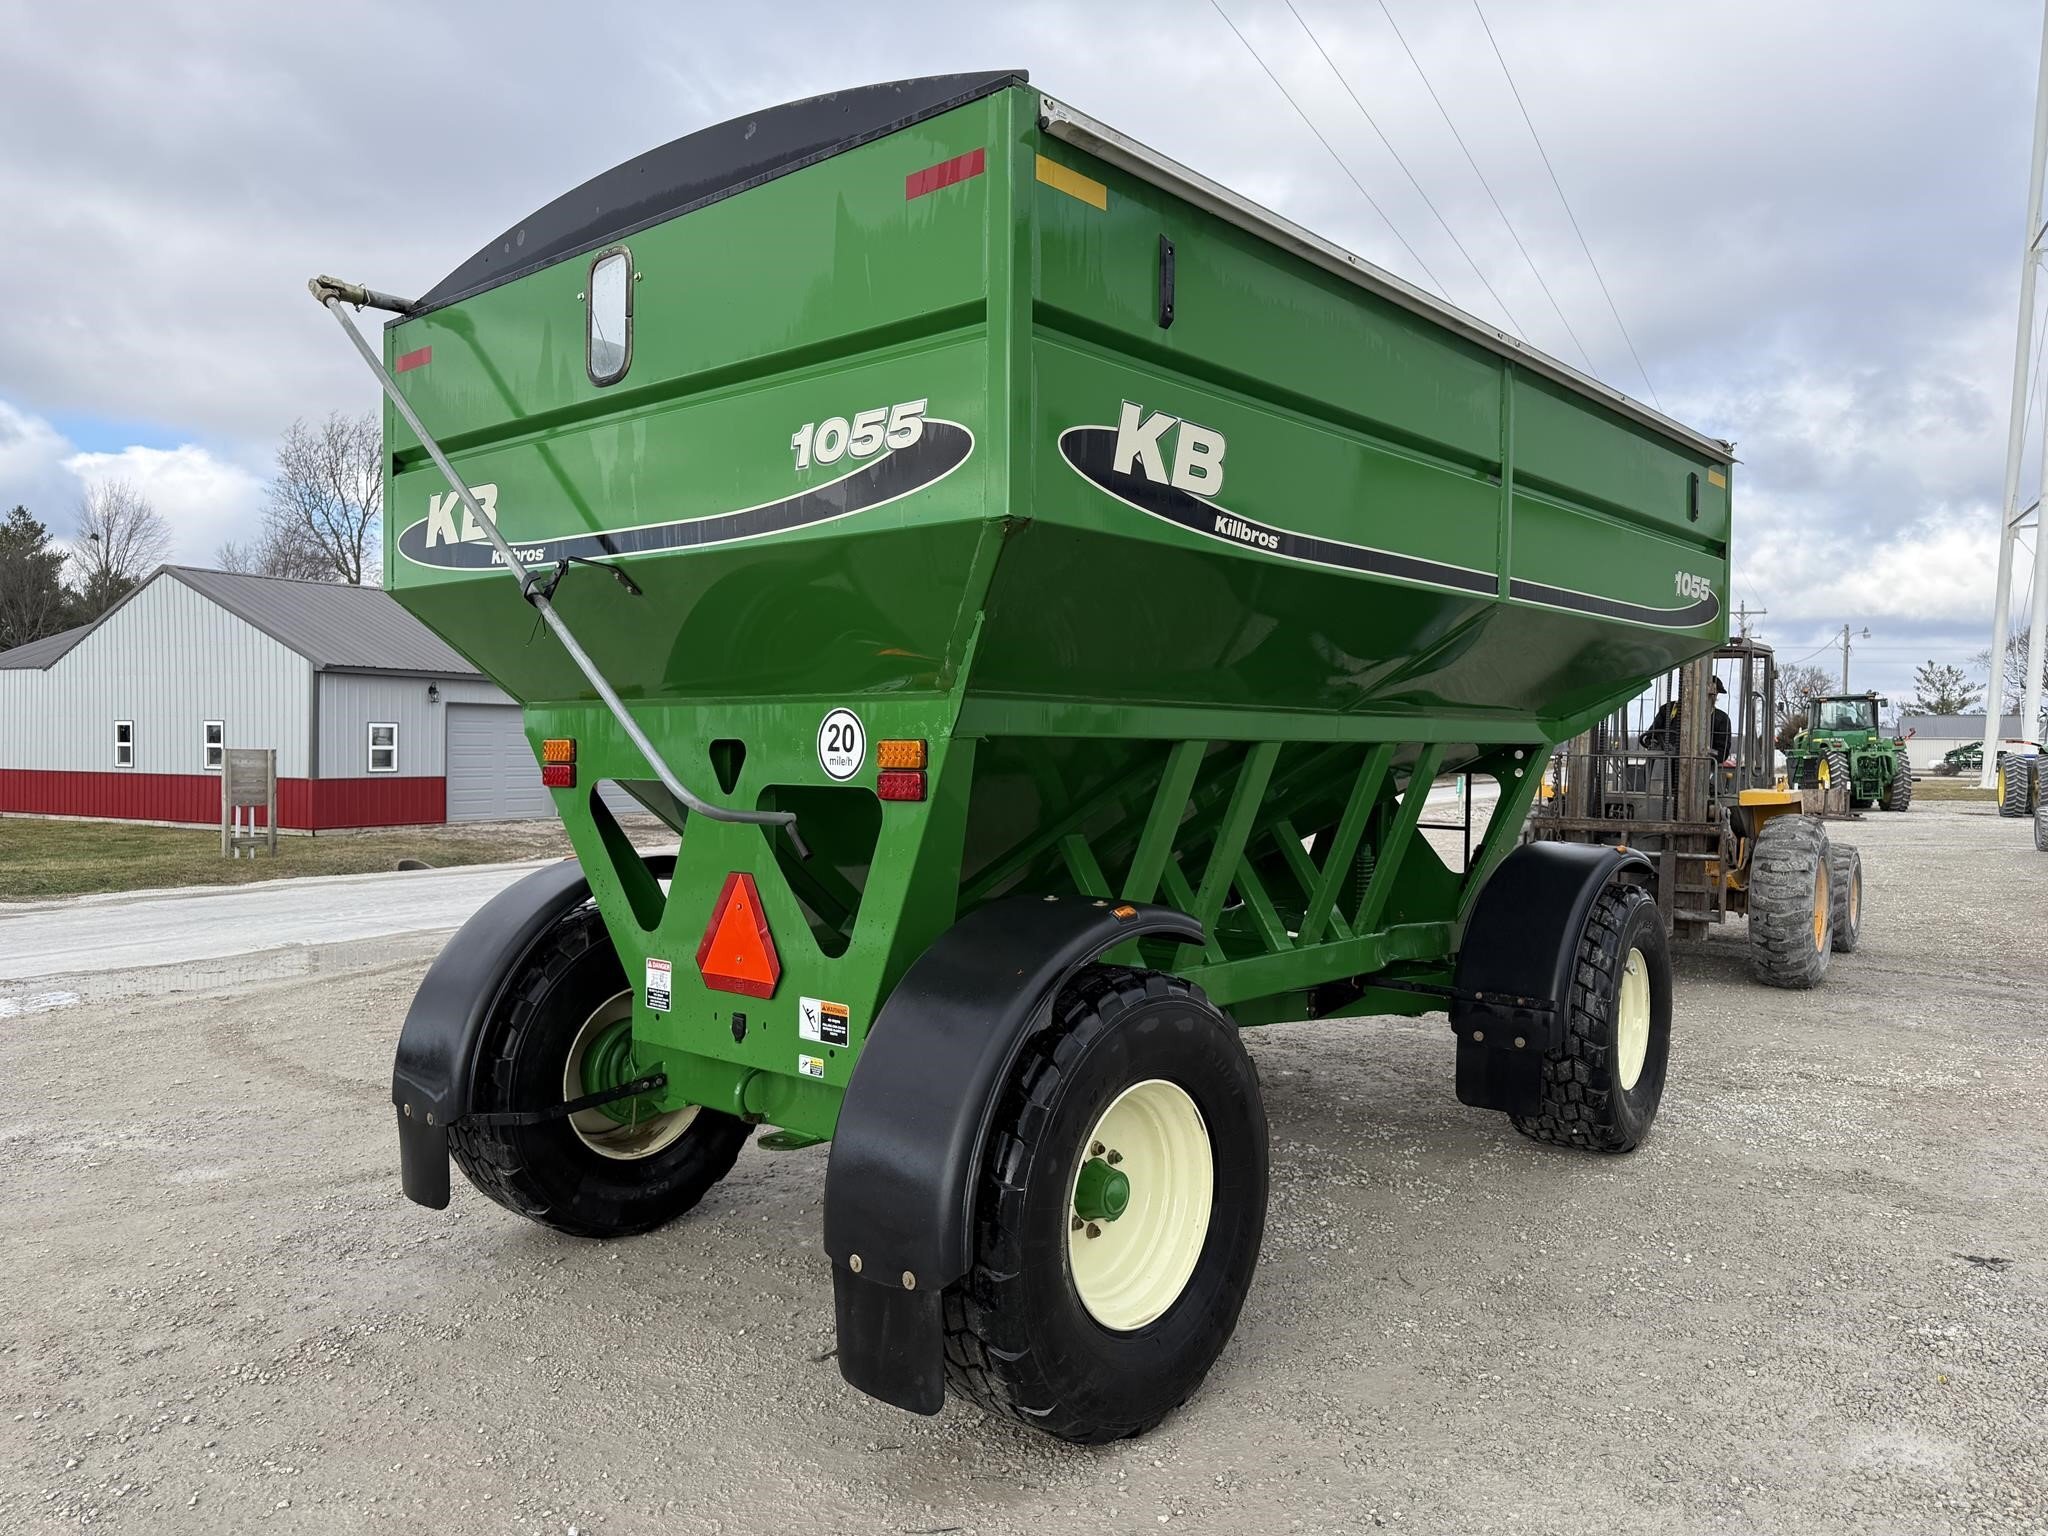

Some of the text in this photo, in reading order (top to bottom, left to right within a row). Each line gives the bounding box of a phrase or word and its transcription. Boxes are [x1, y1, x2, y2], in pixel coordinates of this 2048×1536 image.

[791, 398, 928, 471] 1055
[1113, 399, 1226, 498] KB
[426, 483, 498, 548] KB
[1214, 515, 1280, 549] Killbros
[1674, 570, 1710, 601] 1055
[827, 723, 855, 753] 20
[829, 755, 853, 767] mile/h
